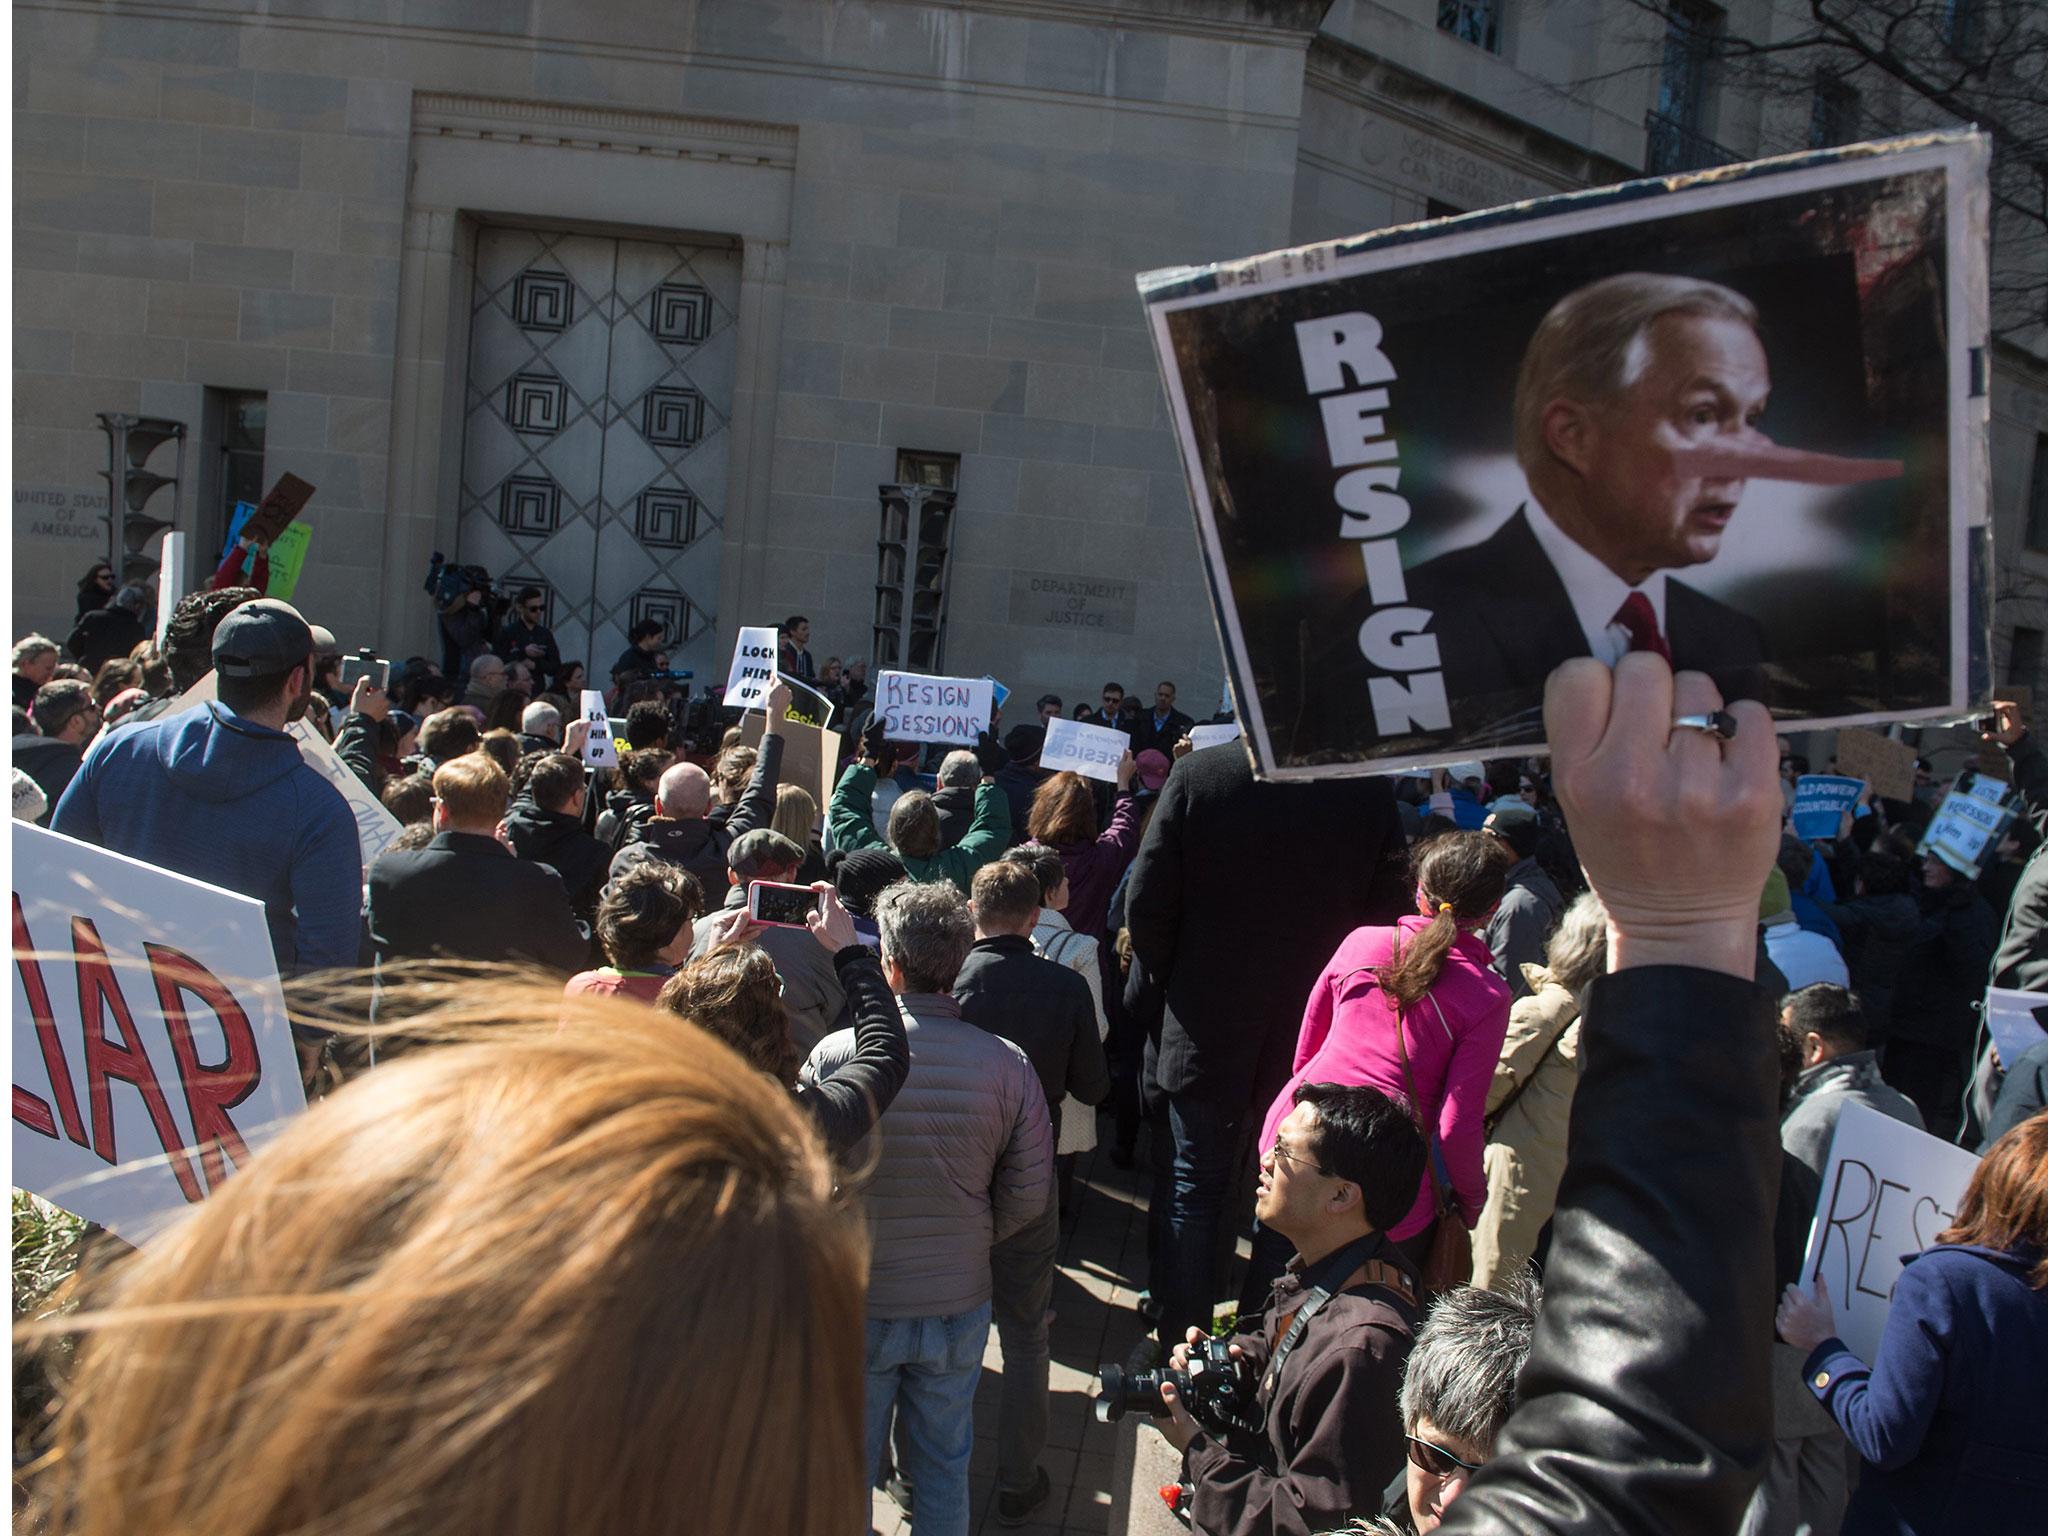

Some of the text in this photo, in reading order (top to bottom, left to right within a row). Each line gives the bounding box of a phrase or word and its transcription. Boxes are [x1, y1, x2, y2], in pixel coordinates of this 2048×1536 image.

[15, 490, 65, 506] UNITED
[56, 508, 76, 521] OF
[30, 521, 99, 539] AMERICA
[1294, 311, 1452, 737] RESIGN
[1030, 579, 1125, 599] DEPARTMENT
[1067, 598, 1087, 610] OF
[1043, 609, 1104, 627] JUSTICE
[742, 667, 771, 680] HIM
[740, 688, 761, 699] UP
[887, 674, 970, 708] RESIGN
[884, 705, 979, 739] SESSIONS
[590, 729, 606, 739] HIM
[1813, 1159, 1956, 1311] RES
